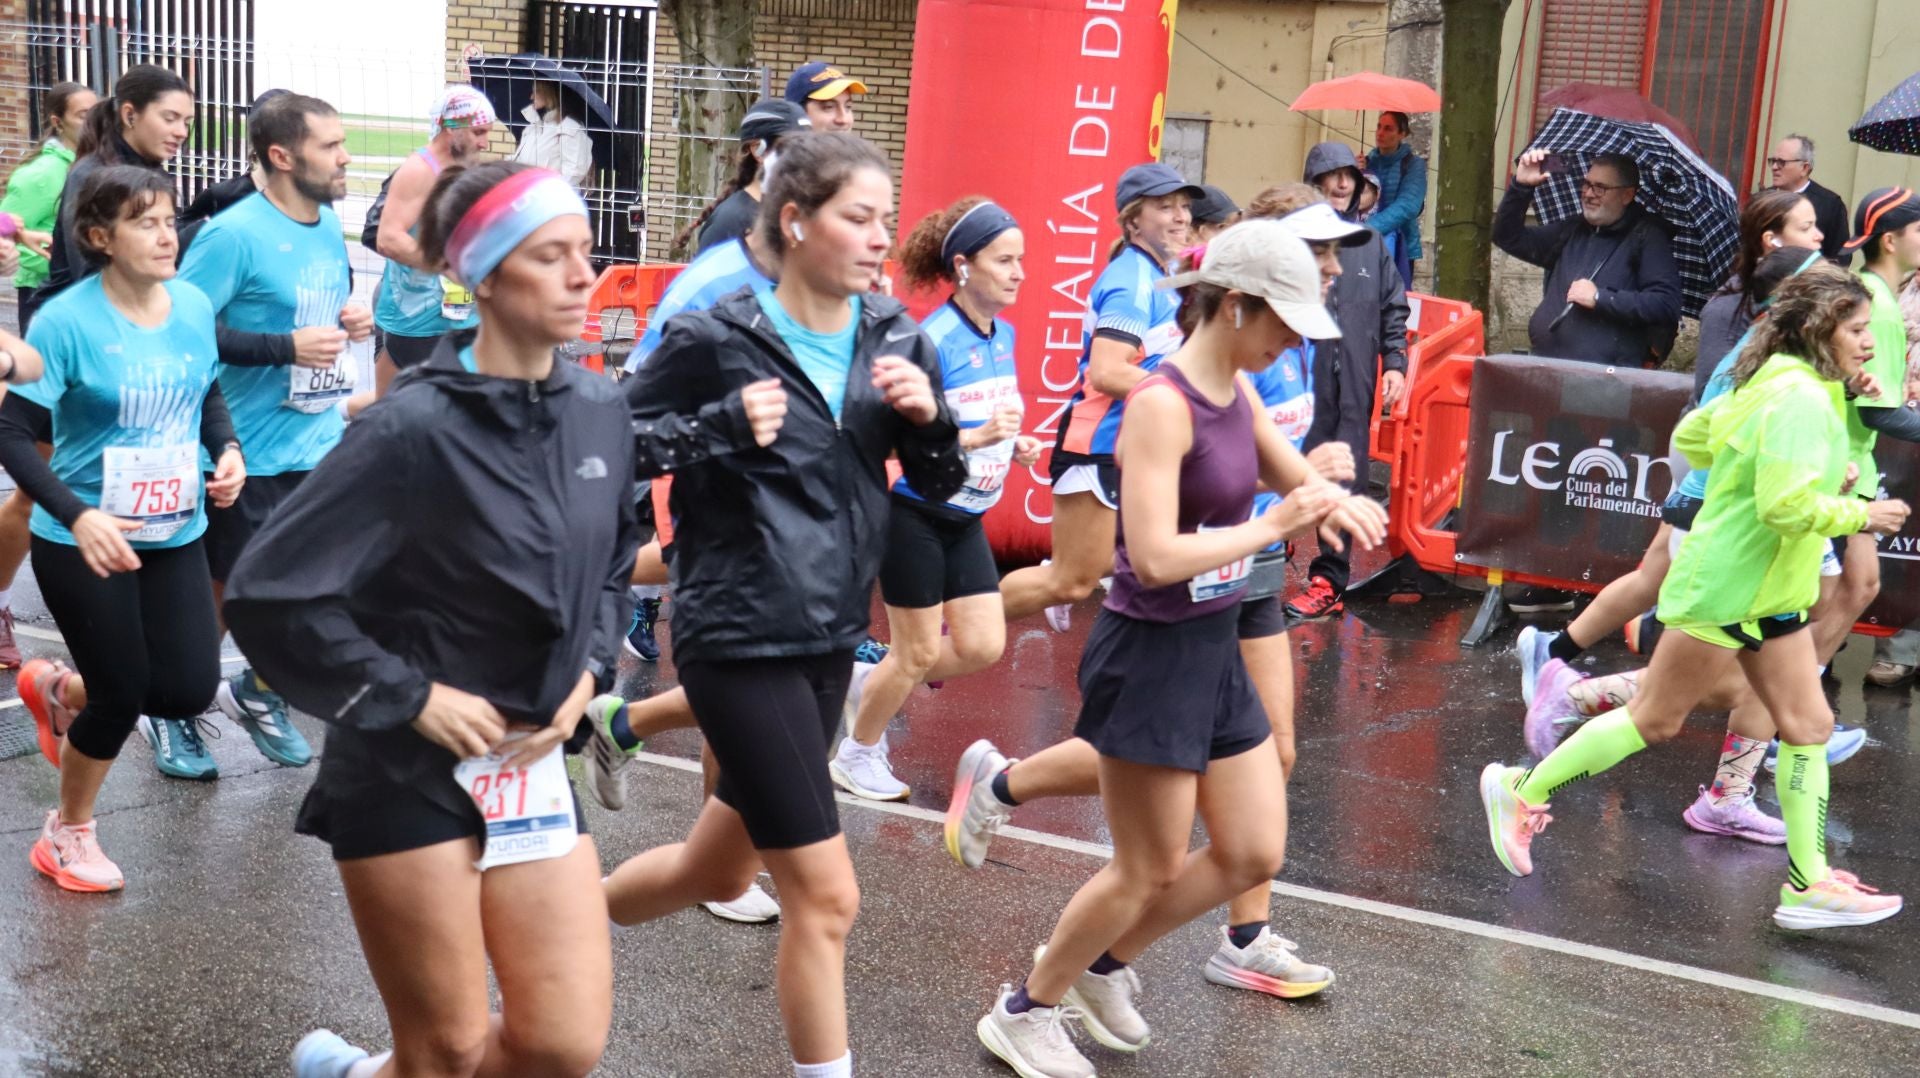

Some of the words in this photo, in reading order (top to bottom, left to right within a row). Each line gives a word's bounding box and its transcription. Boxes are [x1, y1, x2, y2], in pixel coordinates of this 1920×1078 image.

[1068, 84, 1116, 157] DE
[131, 479, 182, 515] 753
[1566, 477, 1601, 494] Cuna
[1605, 481, 1628, 497] del
